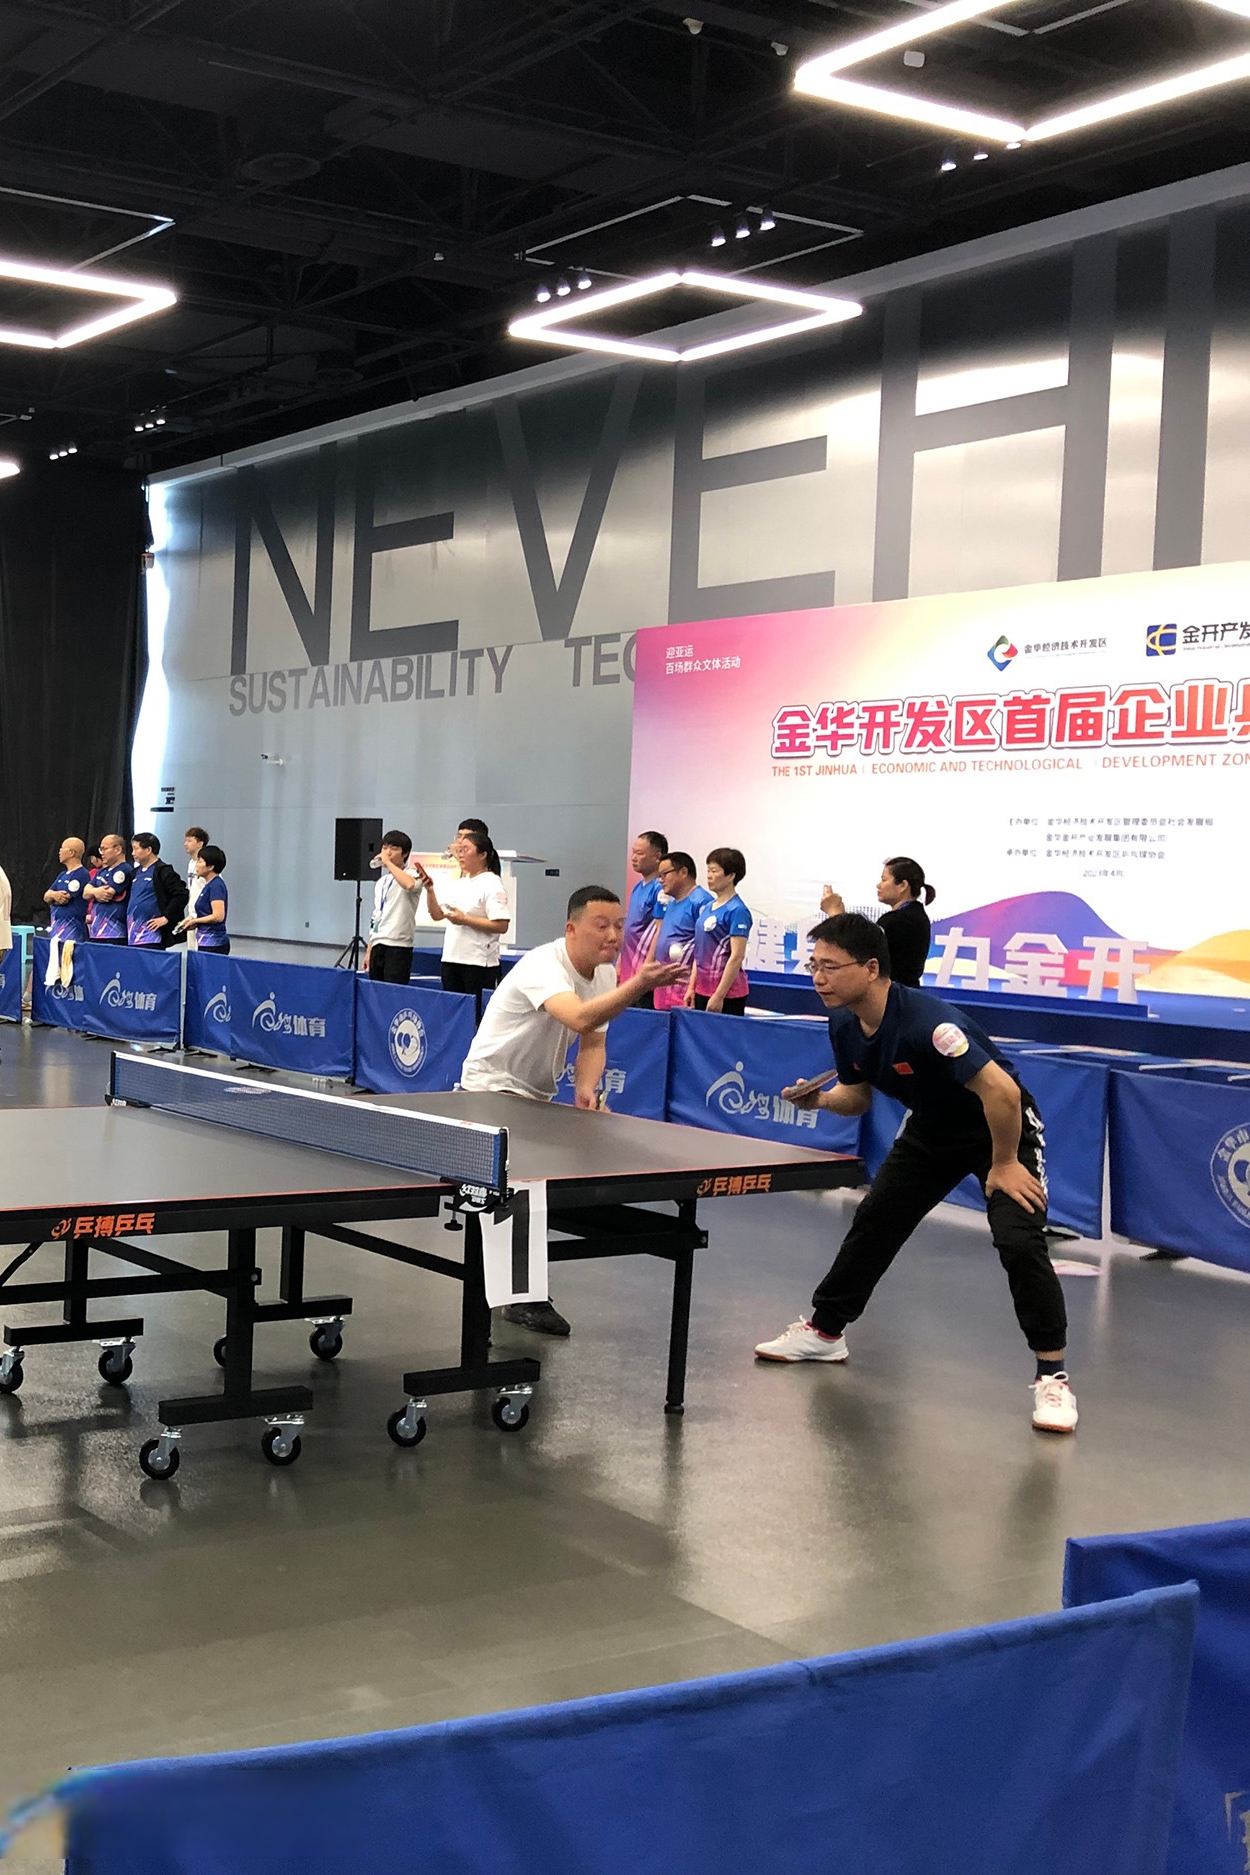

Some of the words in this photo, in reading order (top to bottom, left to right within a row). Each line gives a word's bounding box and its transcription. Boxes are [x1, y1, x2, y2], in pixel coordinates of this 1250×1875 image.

[665, 645, 694, 659] 迎亚运
[1024, 637, 1107, 654] 金华经济技术开发区
[665, 656, 741, 675] 百场群众文体活动
[229, 645, 514, 717] SUSTAINABILITY
[772, 766, 790, 777] THE
[794, 765, 813, 776] 1ST
[815, 763, 857, 776] JINHUA
[872, 761, 936, 774] ECONOMIC
[940, 760, 967, 772] AND
[972, 757, 1082, 772] TECHNOLOGICAL
[1102, 753, 1217, 769] DEVELOPMENT
[493, 1189, 530, 1295] 1
